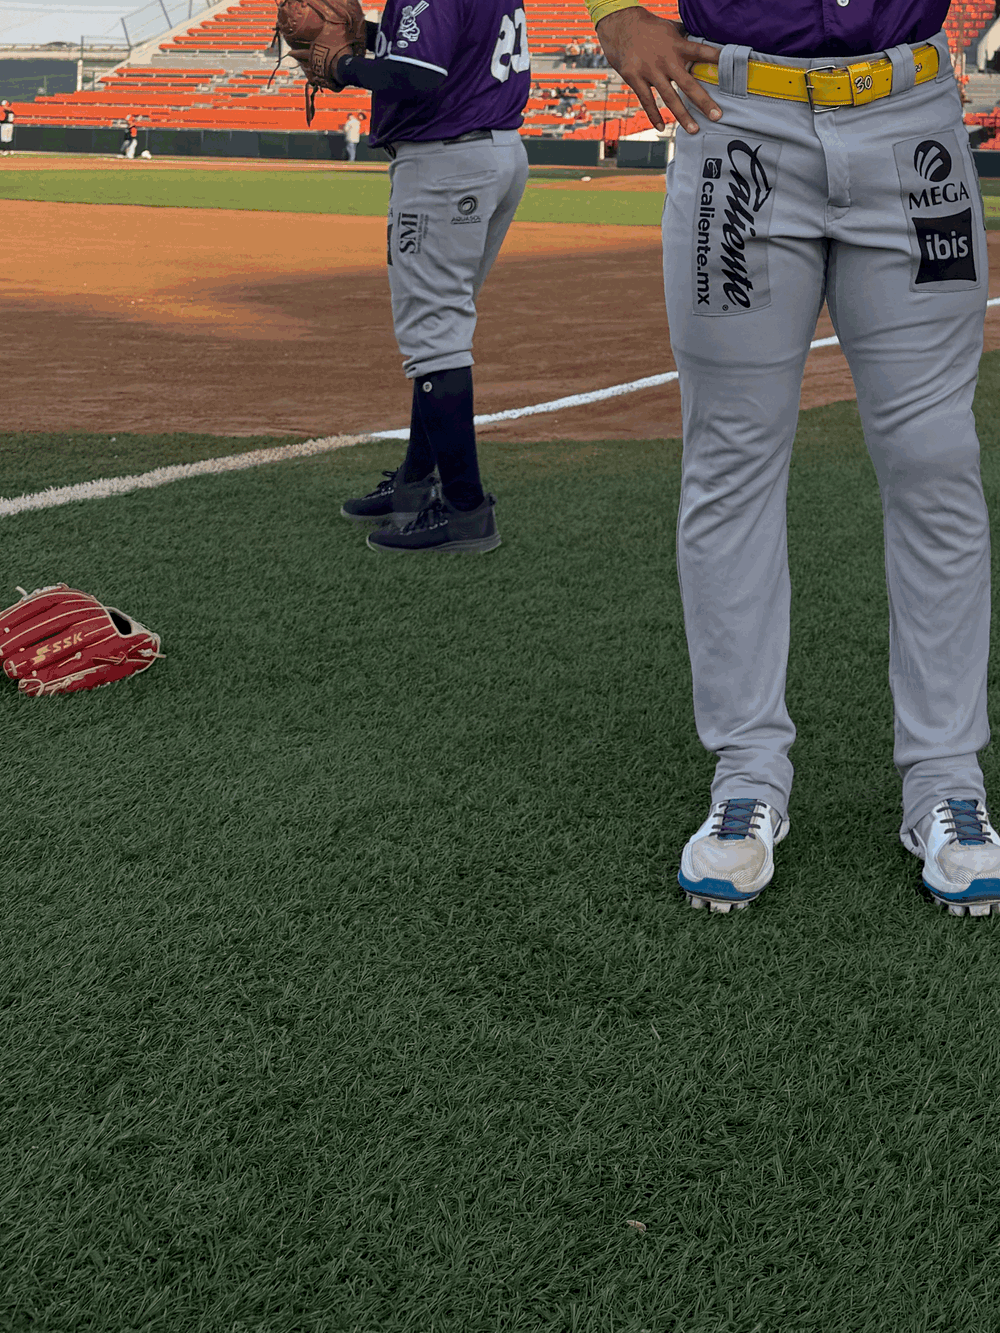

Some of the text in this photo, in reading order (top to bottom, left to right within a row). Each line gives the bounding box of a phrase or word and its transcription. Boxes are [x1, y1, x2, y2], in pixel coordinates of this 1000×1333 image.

[855, 74, 873, 94] 30
[909, 181, 970, 210] MEGA
[399, 213, 418, 254] SMI
[720, 139, 772, 309] Caliente
[696, 181, 716, 306] caliente.mx
[925, 230, 969, 261] ibis
